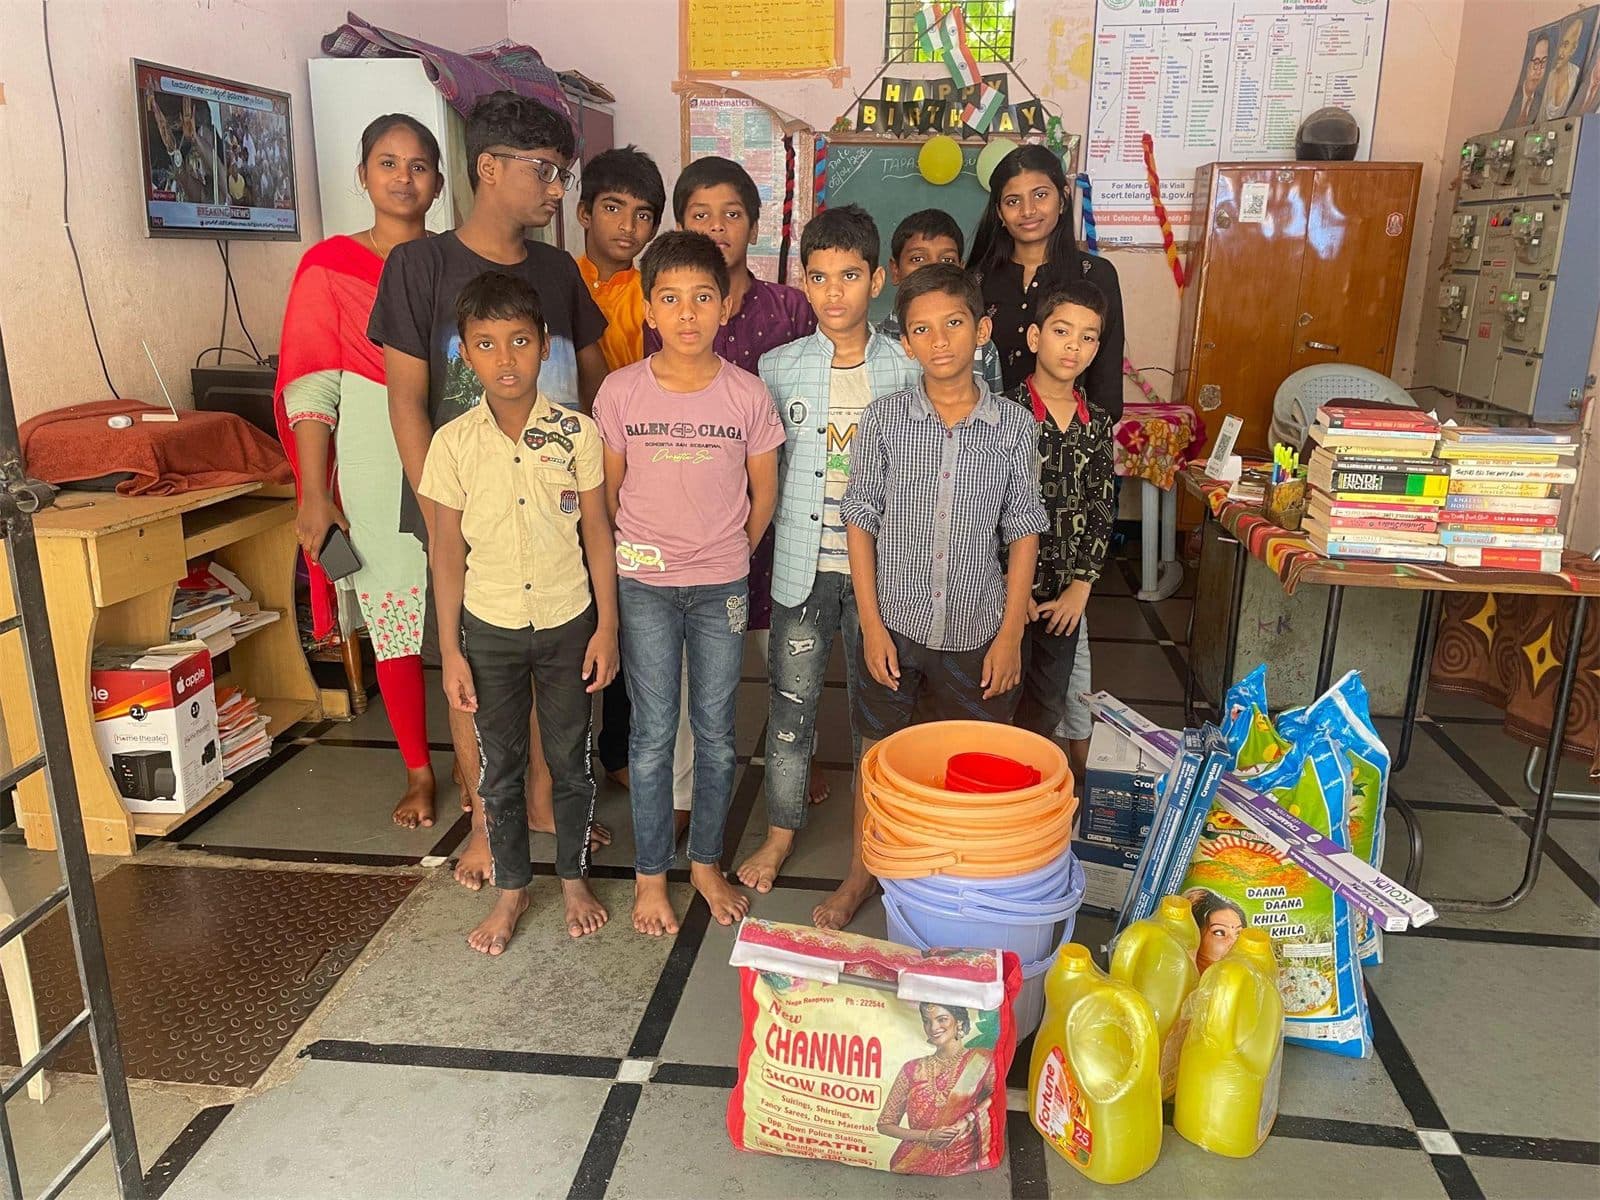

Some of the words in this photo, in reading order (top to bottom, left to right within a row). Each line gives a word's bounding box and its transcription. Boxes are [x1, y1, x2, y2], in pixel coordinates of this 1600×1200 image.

[699, 99, 750, 107] Mathematics
[863, 105, 1036, 132] BIRTHAY
[1101, 191, 1195, 200] scert.telanga.gov.in
[197, 207, 230, 217] BREAKING
[625, 422, 670, 437] BALEN
[698, 424, 742, 440] CIAGA
[1343, 481, 1379, 490] ENGLISH
[185, 668, 205, 688] apple
[131, 708, 144, 717] 2.1
[1200, 762, 1219, 798] Crompton
[1247, 887, 1285, 898] DAANA
[1370, 877, 1413, 905] ECOLINK
[1265, 898, 1303, 910] DAANA
[1253, 913, 1287, 925] KHILA
[1271, 925, 1304, 937] KHILA
[768, 1000, 802, 1024] New
[765, 1022, 882, 1079] CHANNAA
[766, 1068, 815, 1092] SHOW
[821, 1082, 875, 1105] ROOM
[1039, 1063, 1055, 1129] fortune
[760, 1098, 782, 1112] Fancy
[784, 1108, 811, 1121] Sarees,
[813, 1114, 835, 1126] Dress
[838, 1120, 875, 1132] Materials
[781, 1094, 813, 1111] Suitings,
[816, 1105, 852, 1120] Shirtings,
[758, 1122, 873, 1154] TADIPATRI.
[786, 1123, 806, 1134] Town
[808, 1127, 832, 1138] Police
[1074, 1126, 1090, 1146] 25
